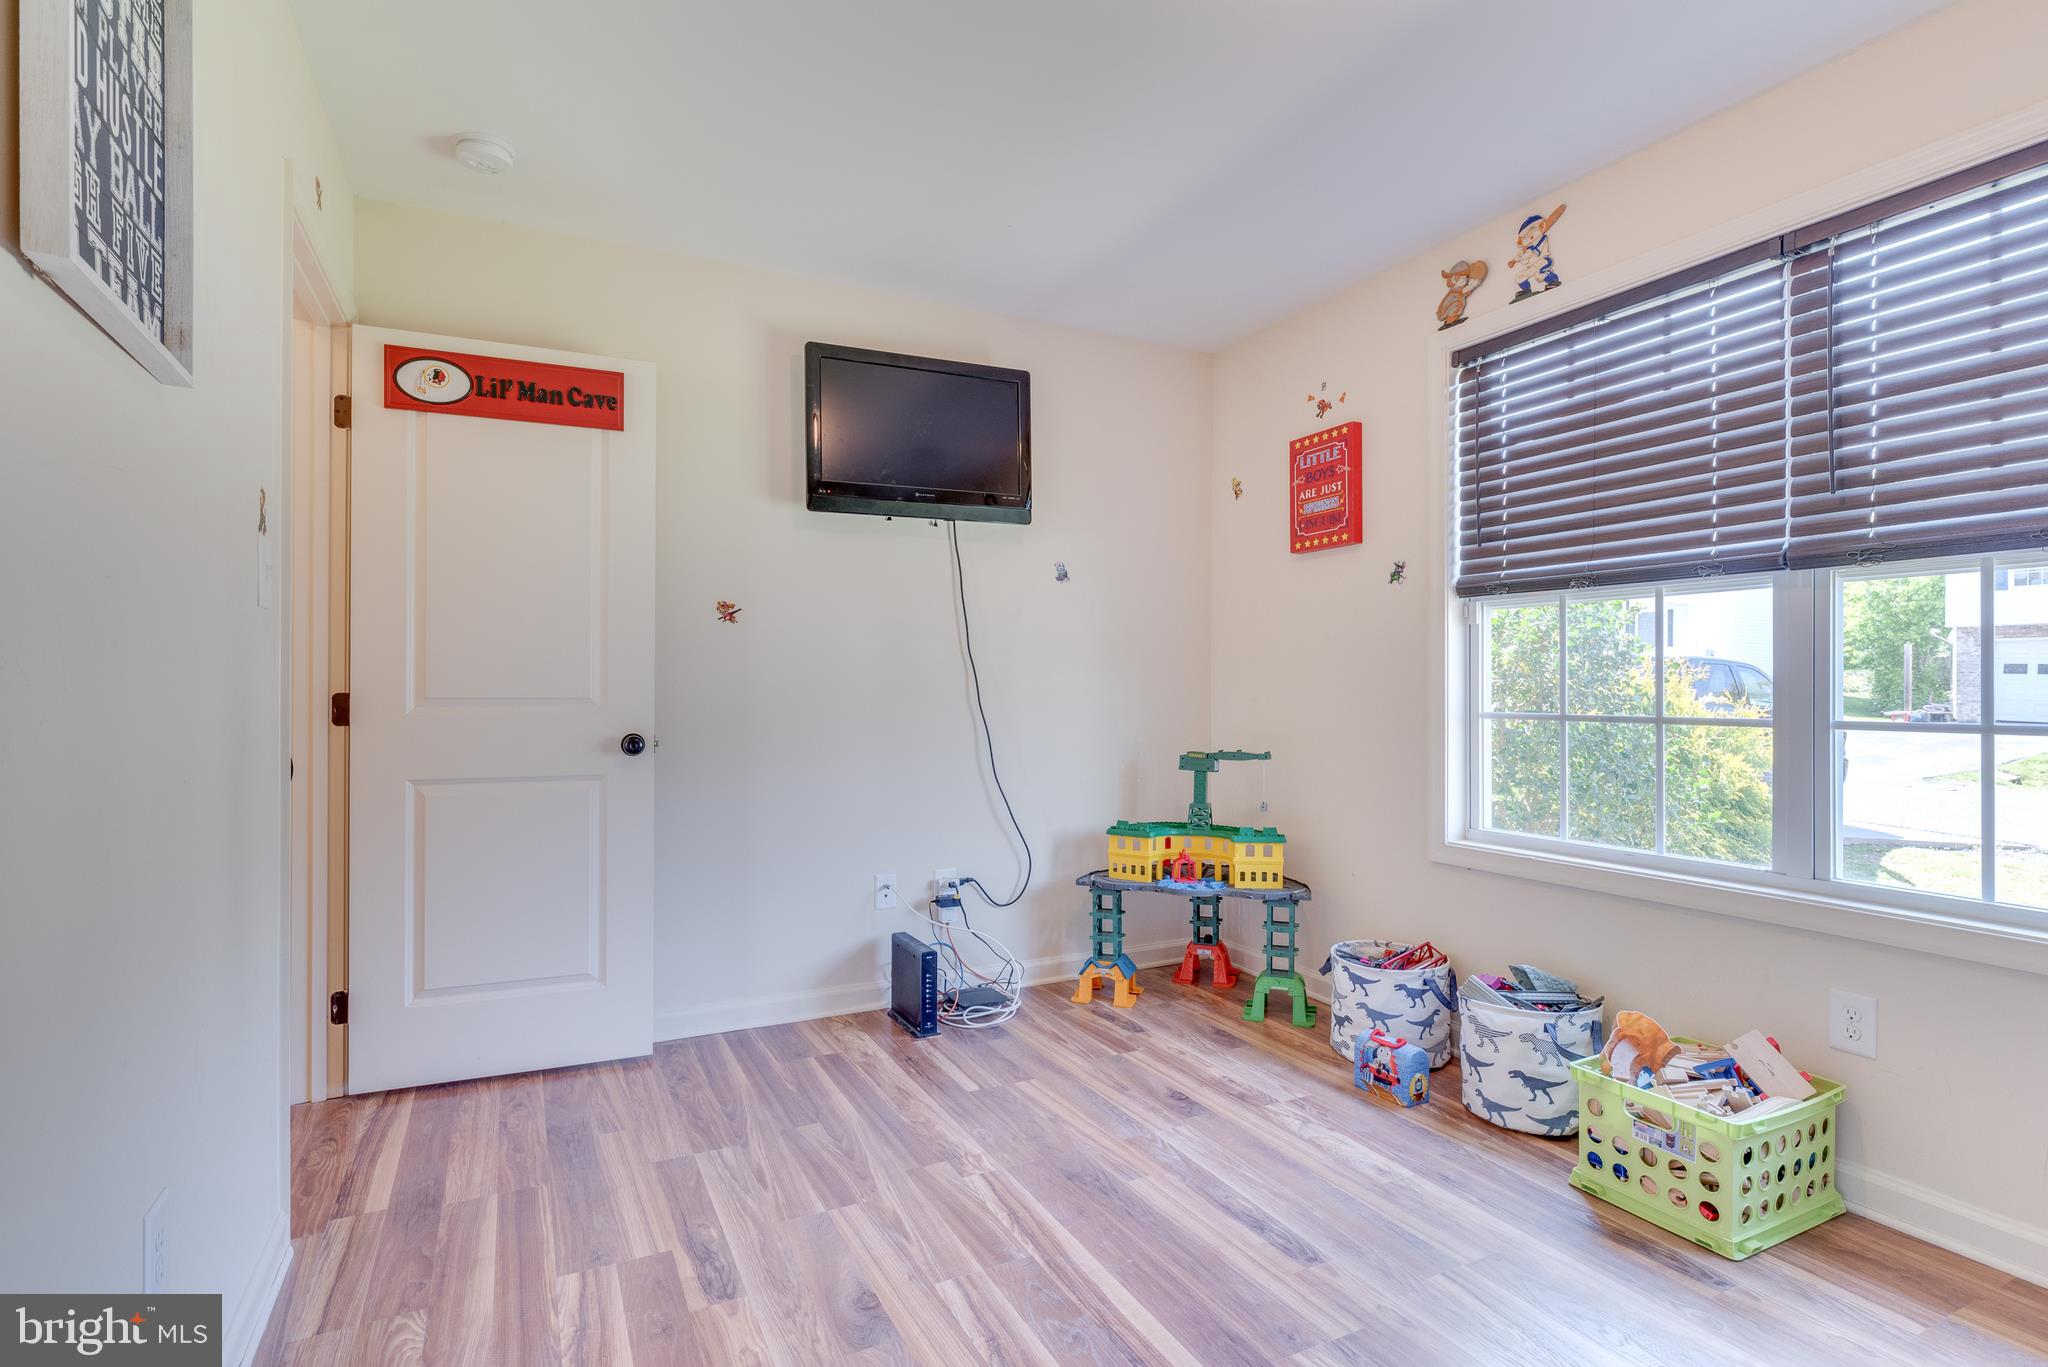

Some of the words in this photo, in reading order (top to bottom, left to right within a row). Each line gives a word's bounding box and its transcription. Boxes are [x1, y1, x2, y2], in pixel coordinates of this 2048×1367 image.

[98, 4, 162, 143] PLAYER
[96, 47, 162, 202] HUSTLE
[109, 134, 163, 257] BALL
[112, 196, 163, 304] FIVE
[517, 381, 564, 406] Man
[567, 386, 617, 411] Cave
[1299, 446, 1342, 469] LITTLE
[1299, 487, 1317, 500] ARE
[1320, 481, 1343, 495] JUST
[1305, 466, 1336, 484] BOYS
